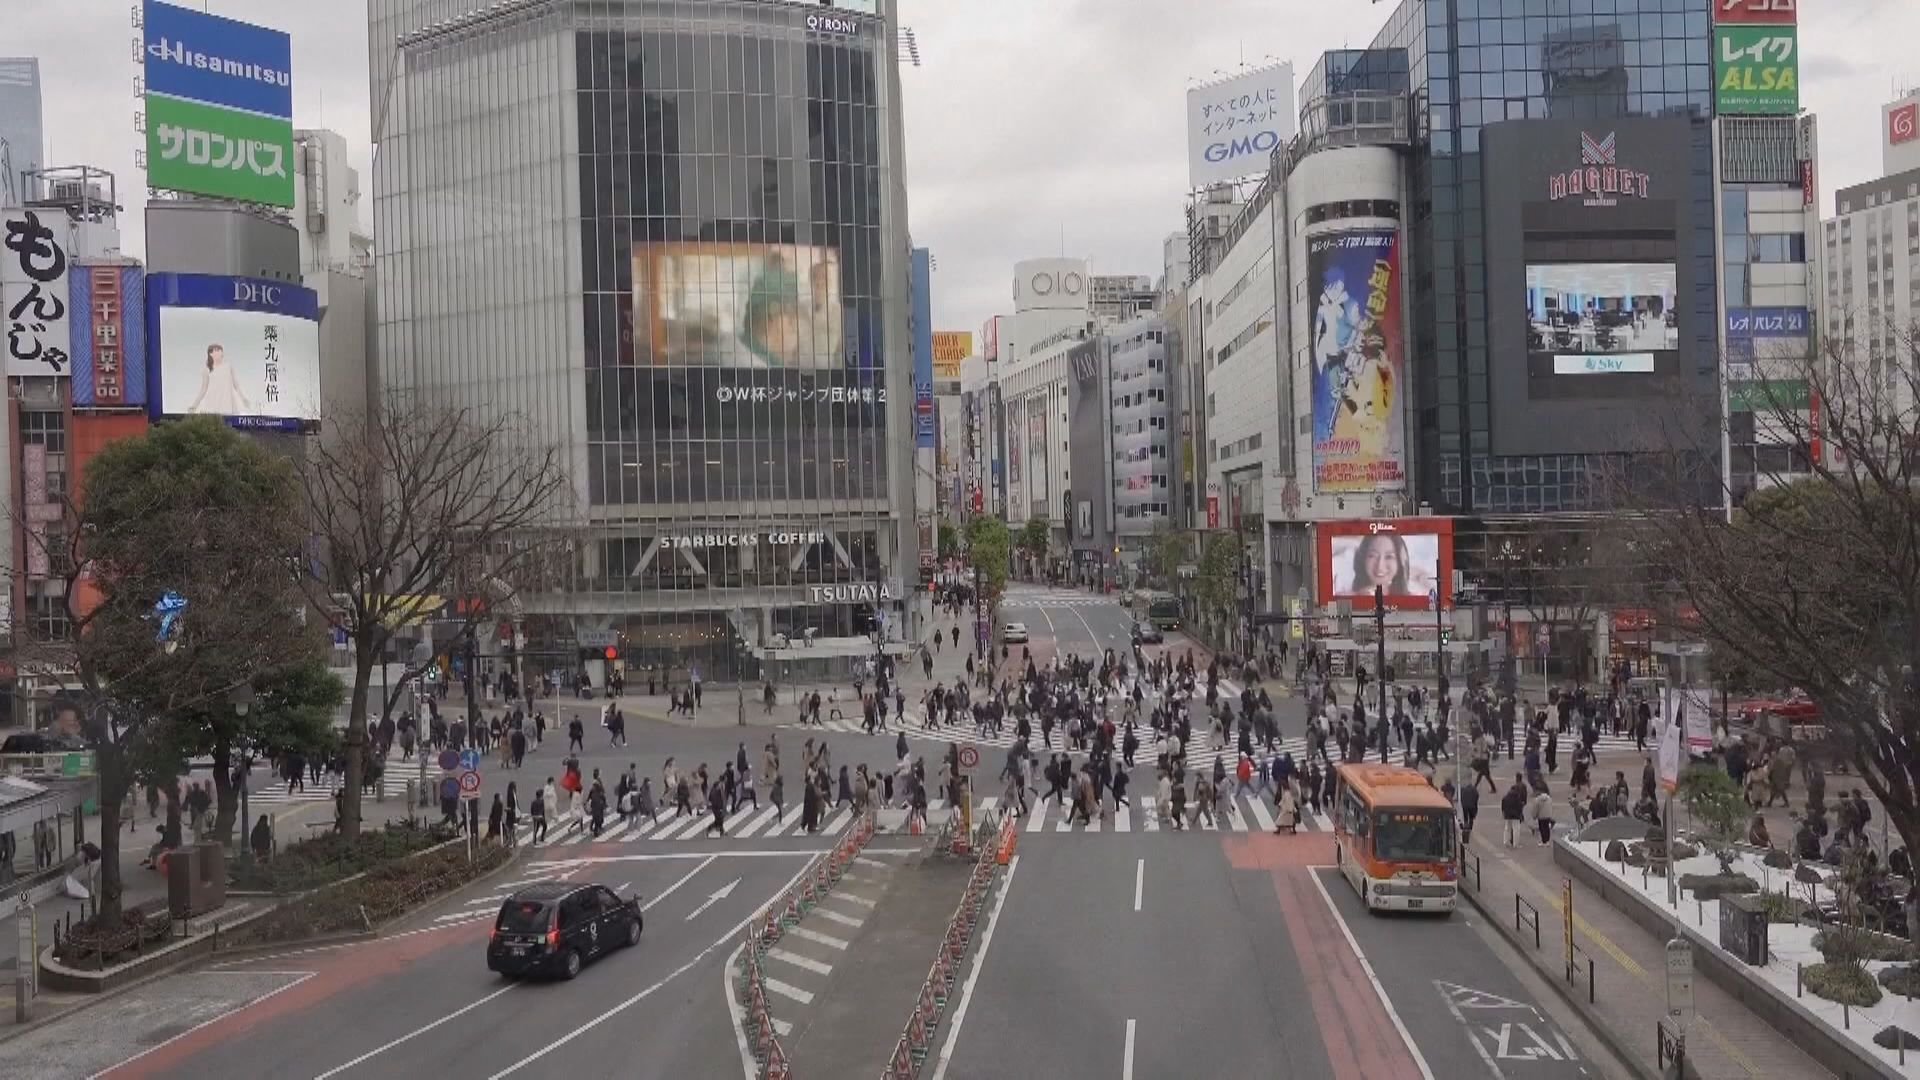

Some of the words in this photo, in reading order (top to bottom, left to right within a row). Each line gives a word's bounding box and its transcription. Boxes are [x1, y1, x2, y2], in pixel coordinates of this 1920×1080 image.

[148, 37, 289, 87] Hisamitsu
[1722, 37, 1793, 62] レイク
[1720, 66, 1795, 91] ALSA
[1202, 88, 1277, 118] すべての人に
[1203, 106, 1278, 136] インターネット
[157, 122, 286, 179] サロンパス
[1204, 130, 1278, 162] GMO
[1550, 167, 1650, 201] MAGNET
[4, 211, 68, 373] もんじゃ
[234, 281, 281, 306] DHC
[95, 271, 121, 398] 三千里薬品
[660, 536, 757, 548] STARBUCKS
[810, 585, 891, 604] TSUTAYA
